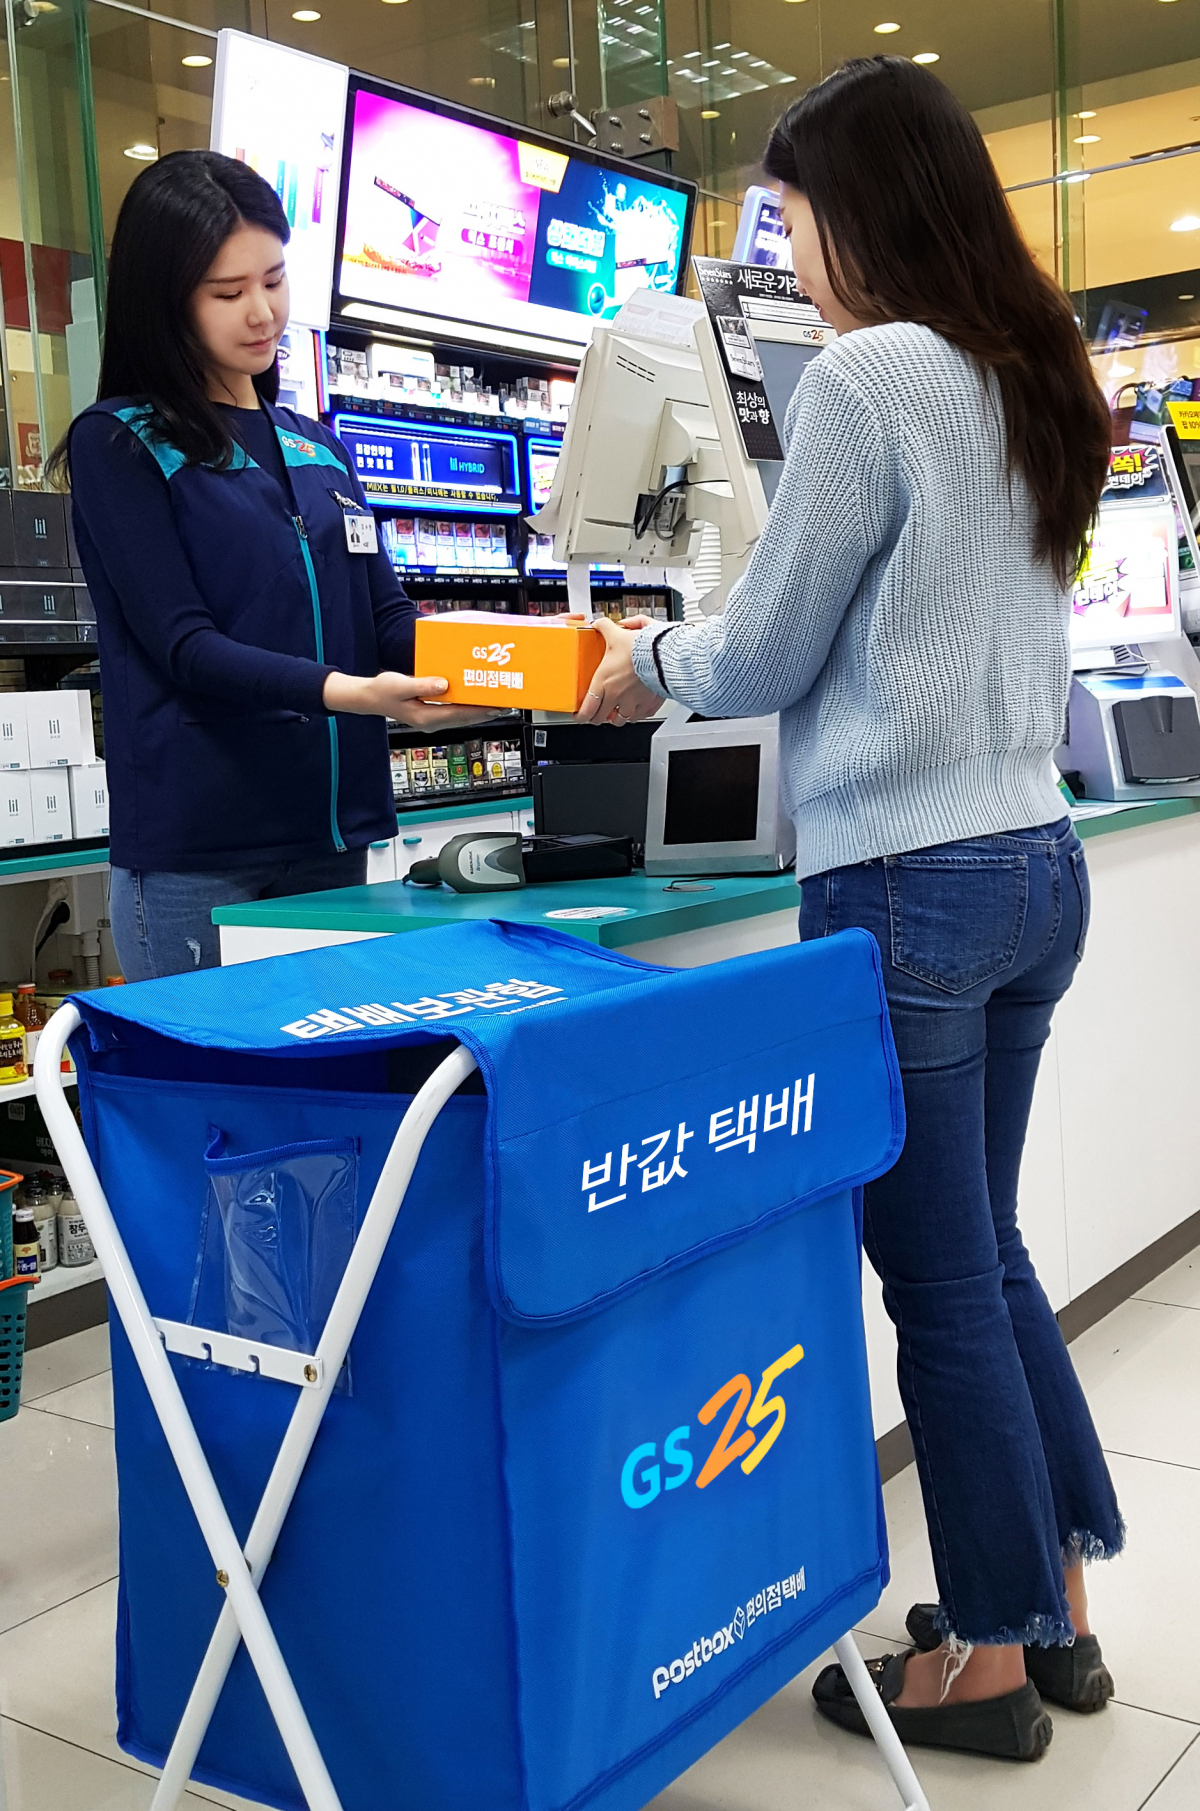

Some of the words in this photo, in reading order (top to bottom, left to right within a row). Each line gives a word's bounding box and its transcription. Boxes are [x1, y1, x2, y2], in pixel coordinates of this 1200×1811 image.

[738, 268, 777, 293] 새로운
[736, 390, 766, 408] 최상의
[281, 436, 316, 457] GS25
[458, 462, 485, 474] HYBRID
[35, 518, 46, 534] lil
[44, 595, 55, 610] lil
[472, 643, 515, 666] GS25
[463, 669, 523, 690] 편의점택배
[49, 719, 60, 734] lil
[9, 799, 18, 813] lil
[47, 795, 57, 809] lil
[280, 978, 564, 1039] 택배보관함
[582, 1121, 694, 1213] 반값
[708, 1073, 815, 1154] 택배
[620, 1343, 805, 1510] GS25
[652, 1622, 735, 1700] postbox
